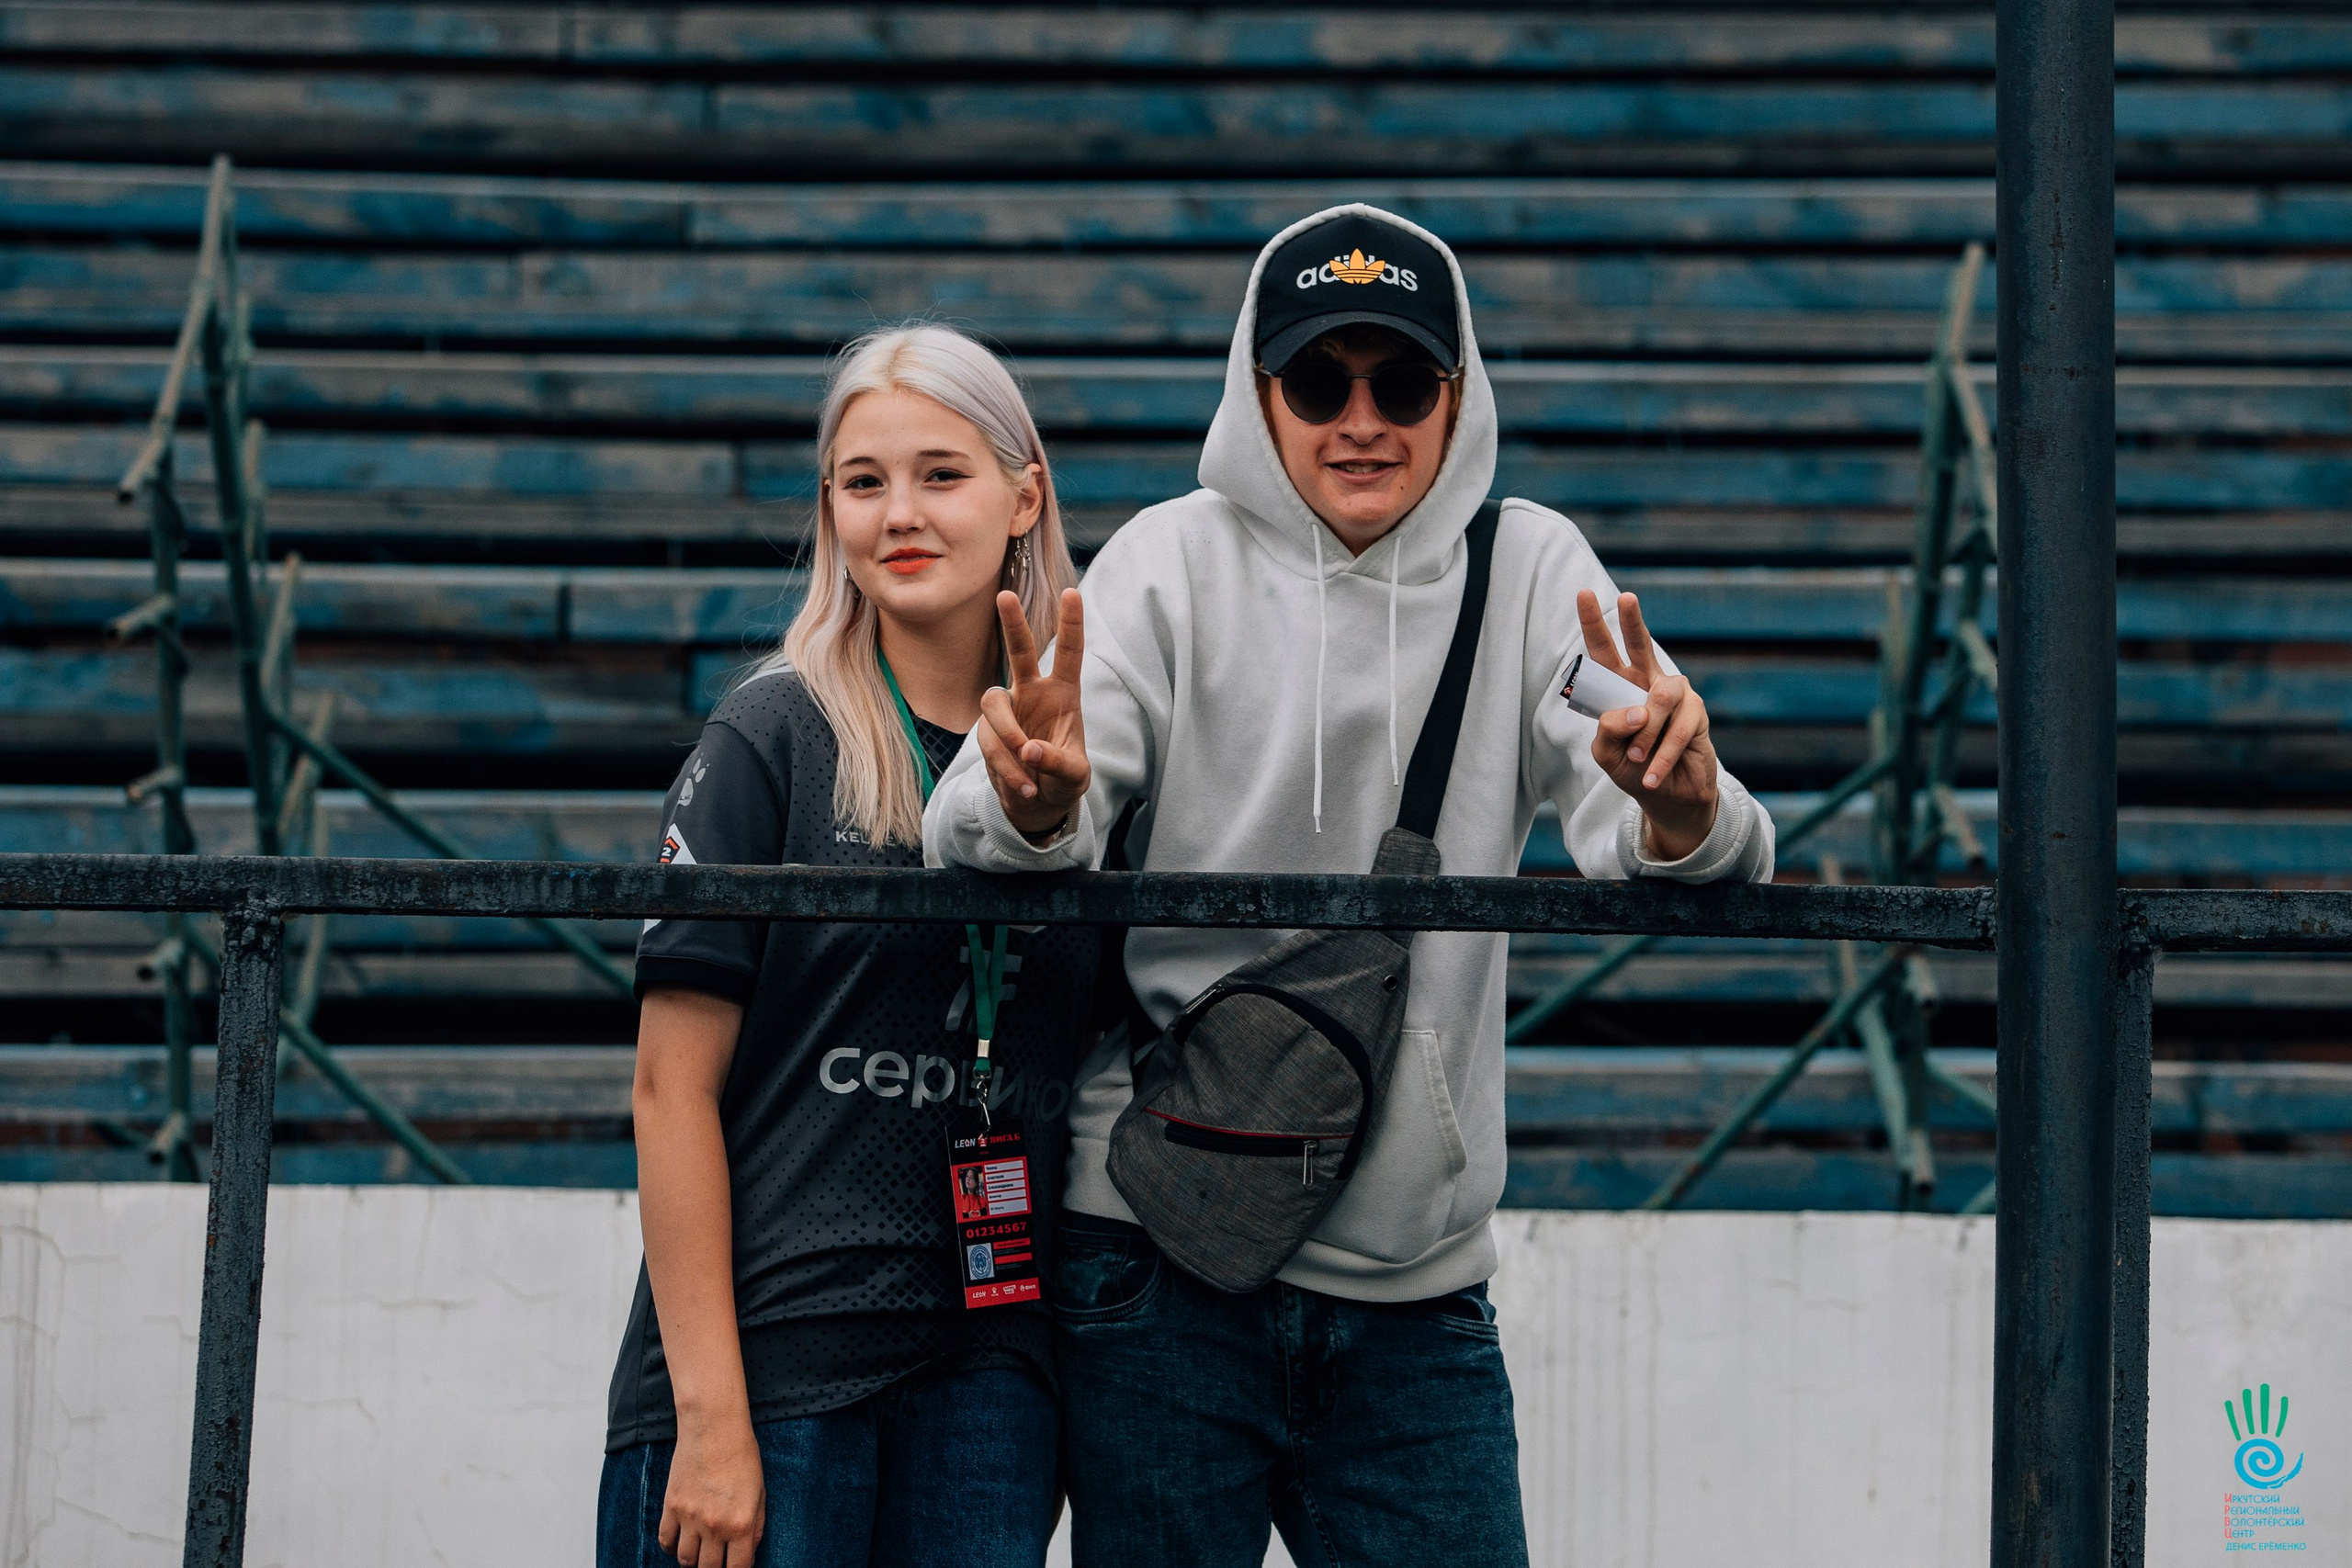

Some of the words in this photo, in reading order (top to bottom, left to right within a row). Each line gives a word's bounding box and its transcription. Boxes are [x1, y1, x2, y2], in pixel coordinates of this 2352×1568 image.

[835, 830, 896, 846] KELE
[662, 847, 672, 857] 2
[955, 1138, 976, 1148] LEON
[989, 1134, 1012, 1144] ЛИГА
[1013, 1133, 1021, 1141] Б
[966, 1222, 1027, 1239] 01234567
[972, 1291, 987, 1299] LEON
